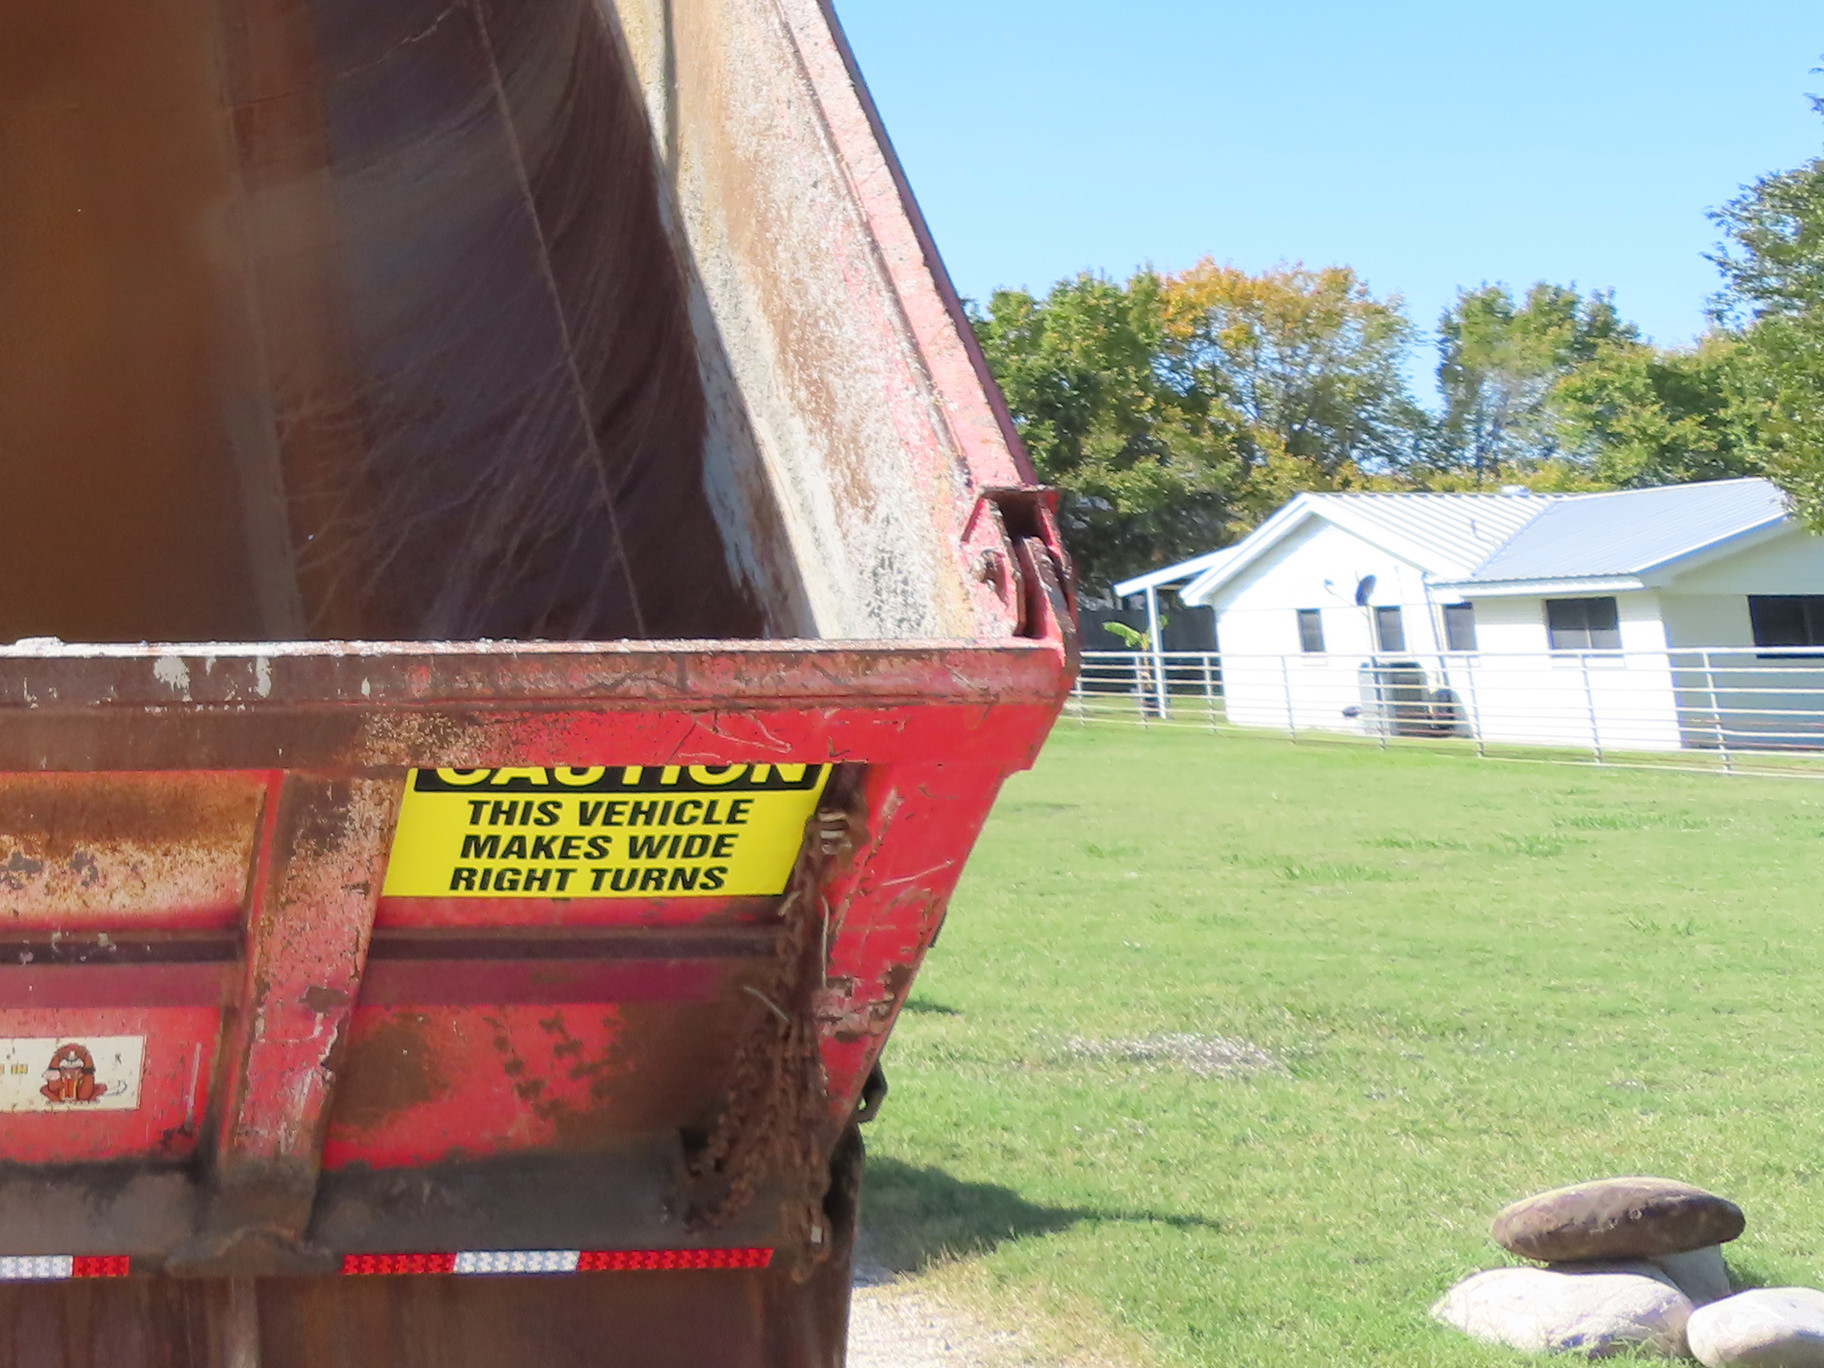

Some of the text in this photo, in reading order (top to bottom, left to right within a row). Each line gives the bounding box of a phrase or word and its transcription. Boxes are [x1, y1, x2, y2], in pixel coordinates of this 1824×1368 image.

[468, 799, 755, 826] THIS VEHICLE
[460, 833, 739, 860] MAKES WIDE
[449, 866, 728, 892] RIGHT TURNS
